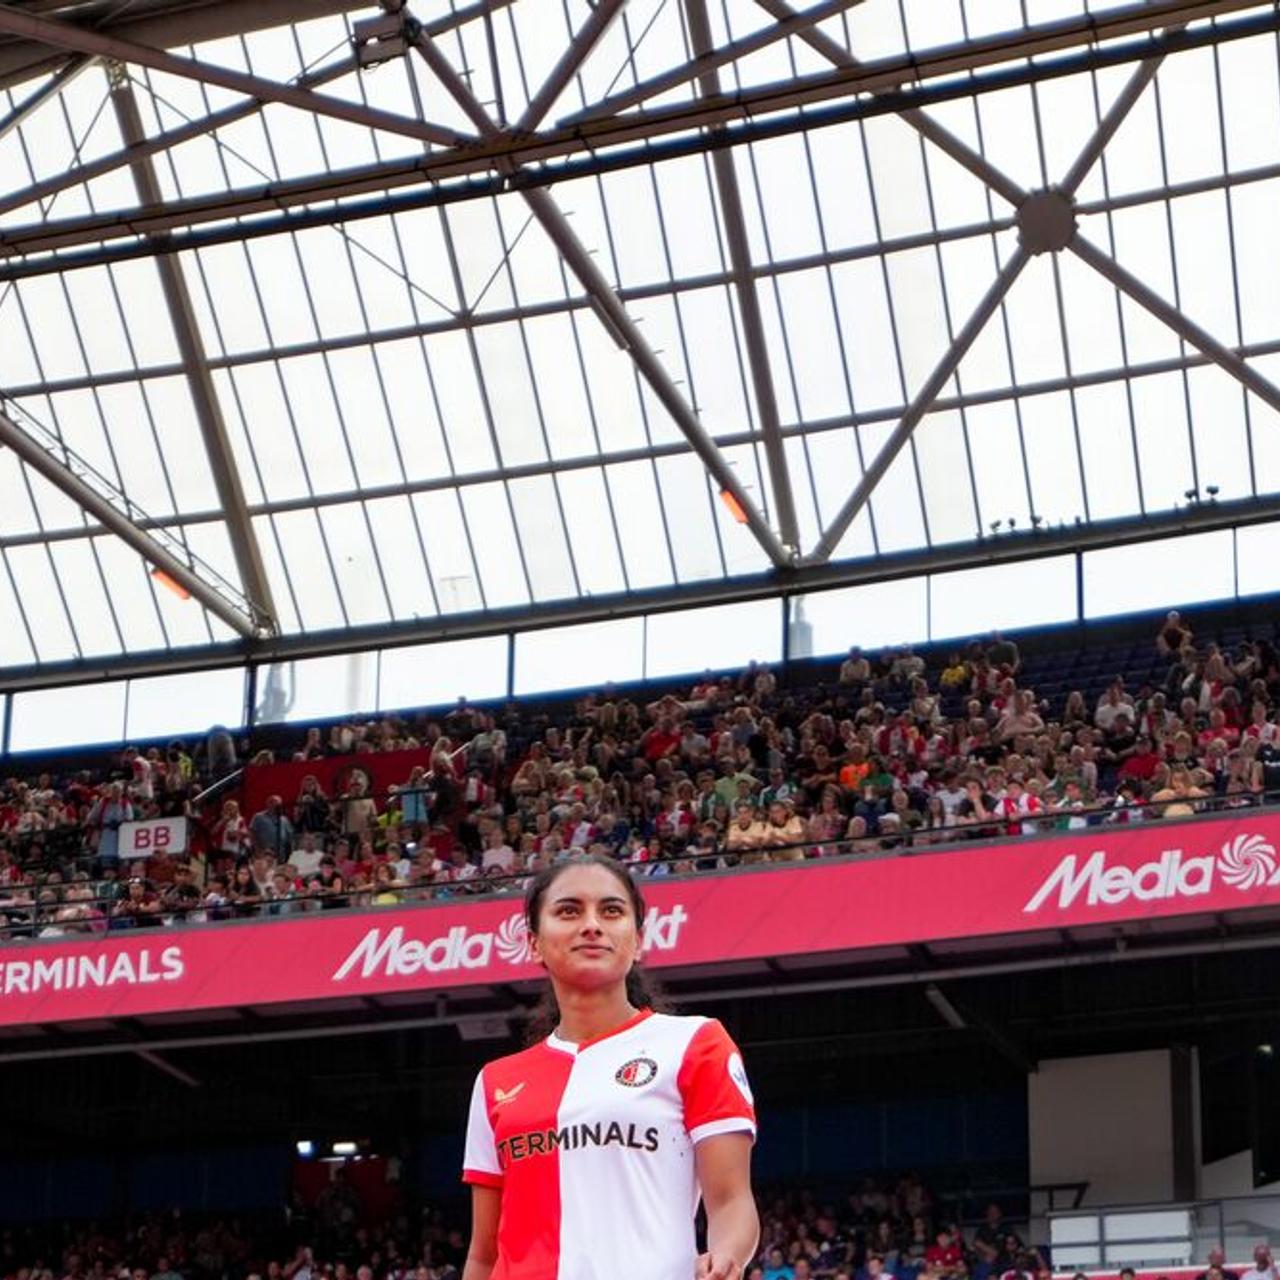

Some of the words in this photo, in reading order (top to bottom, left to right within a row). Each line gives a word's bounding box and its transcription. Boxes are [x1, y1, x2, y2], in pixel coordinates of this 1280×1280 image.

[134, 825, 171, 849] BB
[1023, 850, 1214, 912] Media
[332, 925, 495, 980] Media
